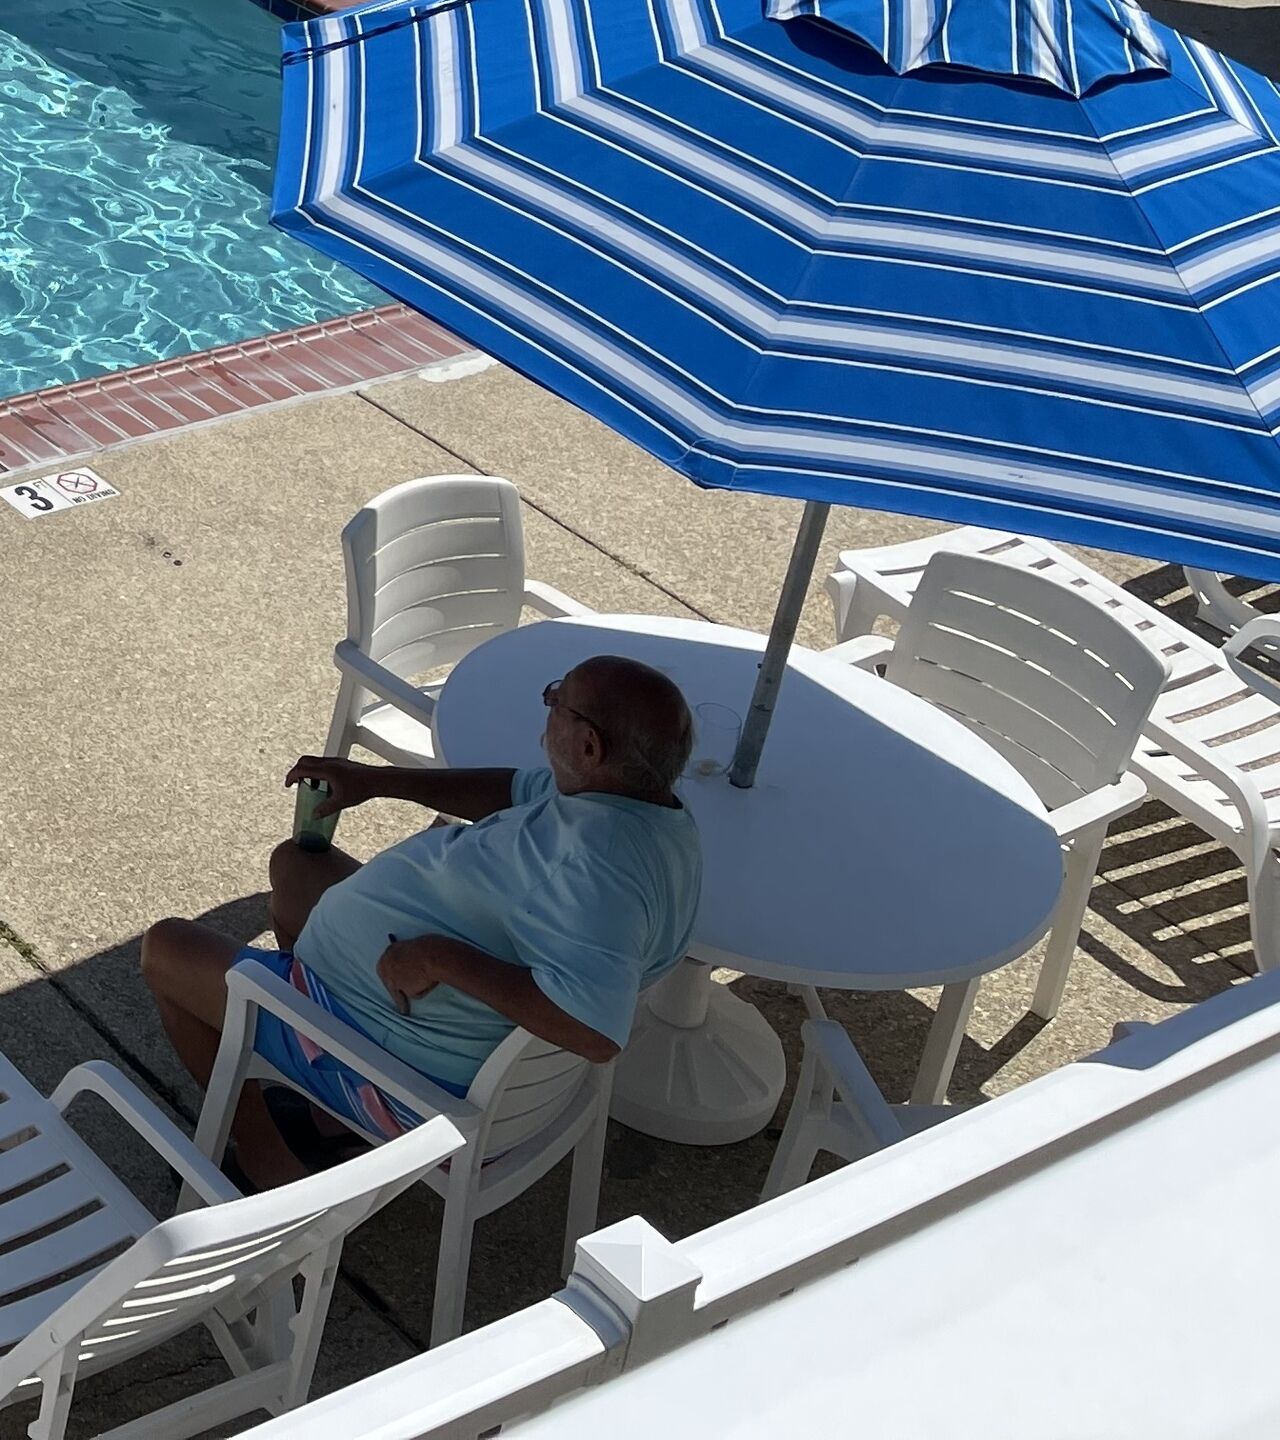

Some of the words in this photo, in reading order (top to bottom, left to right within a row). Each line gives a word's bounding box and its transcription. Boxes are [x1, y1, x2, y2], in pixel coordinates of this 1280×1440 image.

[14, 486, 54, 511] 3
[72, 495, 86, 504] NO
[86, 488, 116, 501] DIVING
